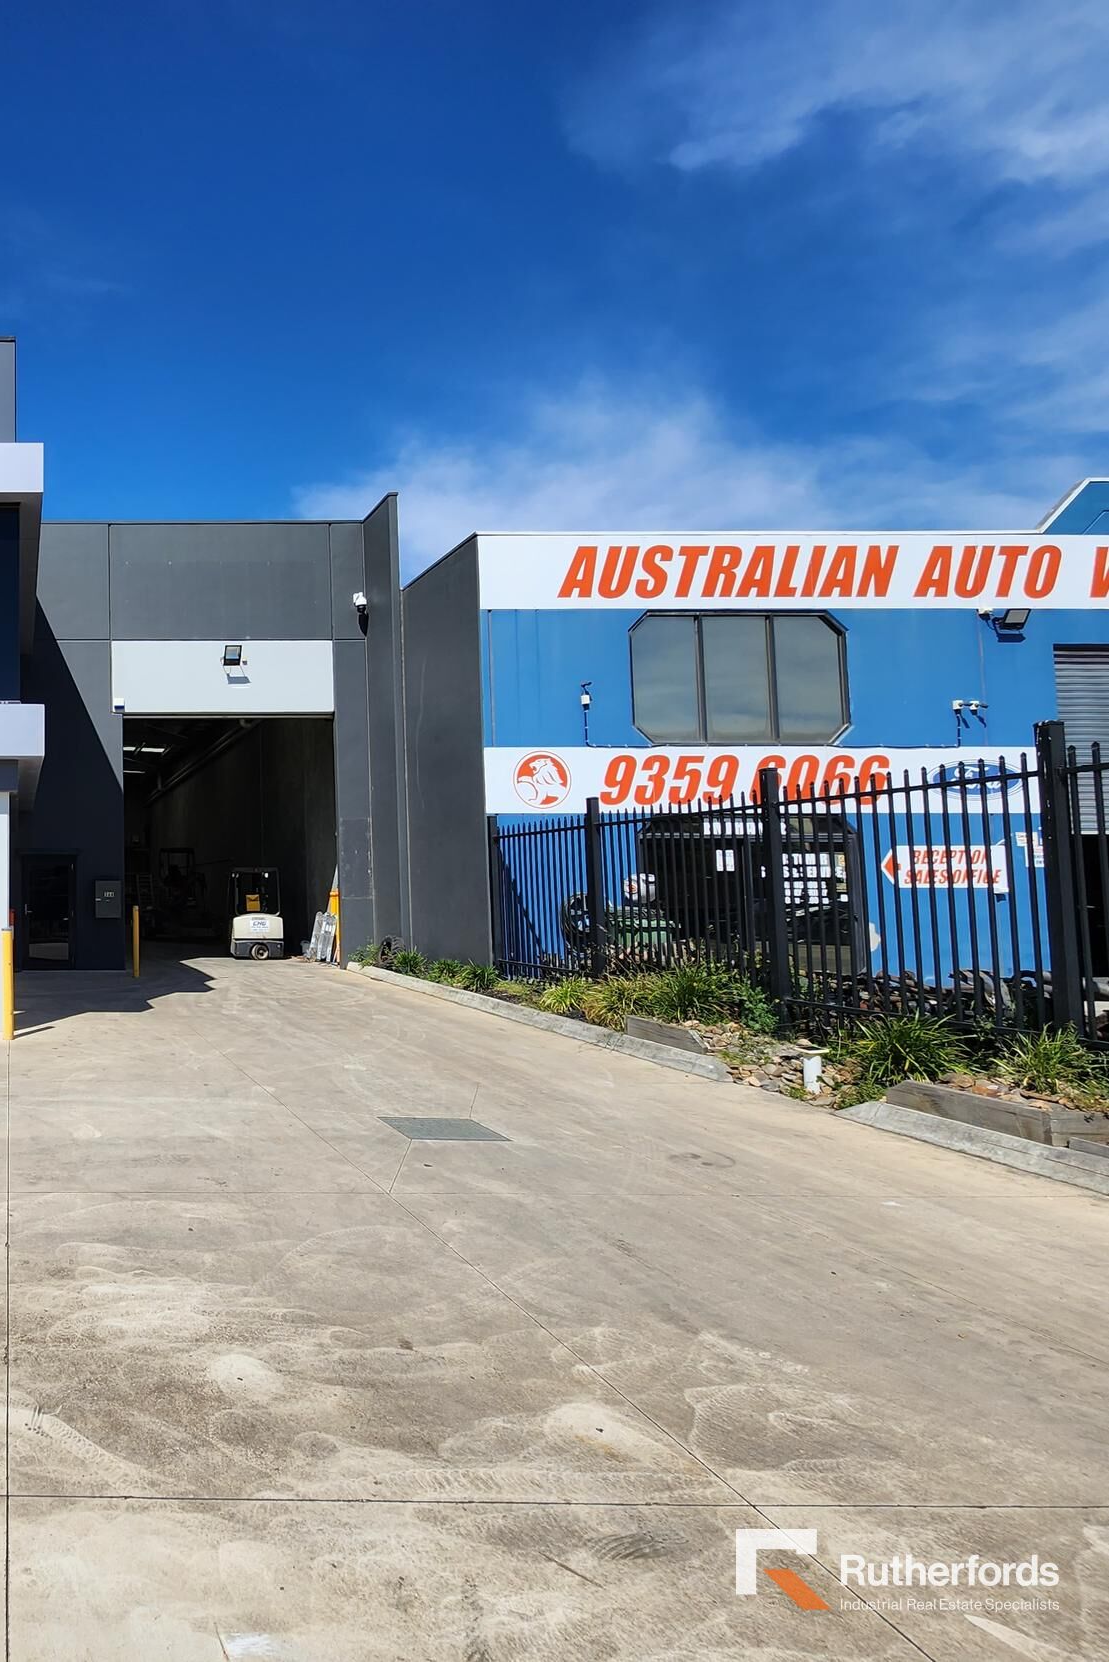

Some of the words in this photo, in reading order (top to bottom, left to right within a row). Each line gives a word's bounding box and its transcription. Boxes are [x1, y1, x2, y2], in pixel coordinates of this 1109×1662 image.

[556, 544, 900, 599] AUSTRALIAN
[913, 544, 1063, 599] AUTO
[599, 754, 741, 806] 9359
[748, 754, 891, 806] 6066
[912, 849, 990, 865] RECEPTON
